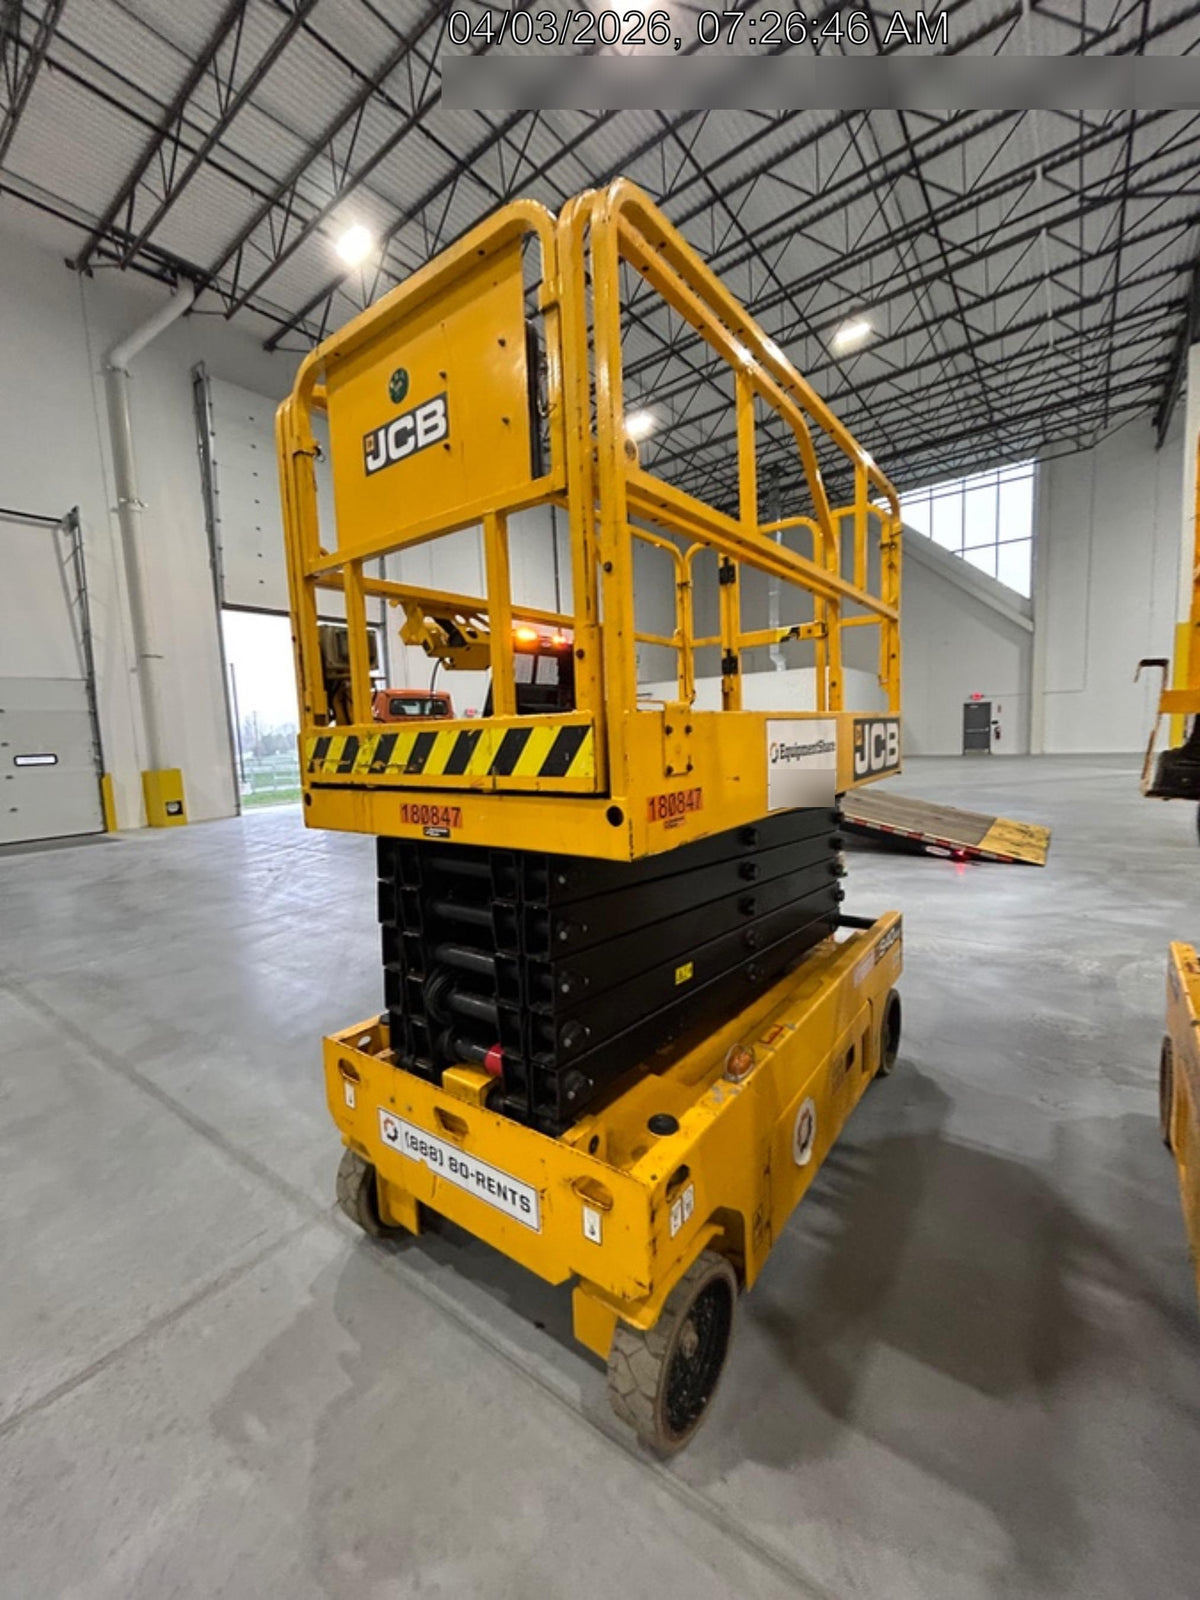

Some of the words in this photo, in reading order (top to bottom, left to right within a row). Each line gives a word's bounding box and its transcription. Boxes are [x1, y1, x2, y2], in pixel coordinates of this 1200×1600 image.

[366, 398, 447, 472] JCB
[854, 722, 899, 775] JCB
[401, 804, 461, 828] 180847
[648, 787, 702, 822] 180847
[405, 1131, 444, 1167] (888)
[448, 1156, 531, 1213] 80-RENTS
